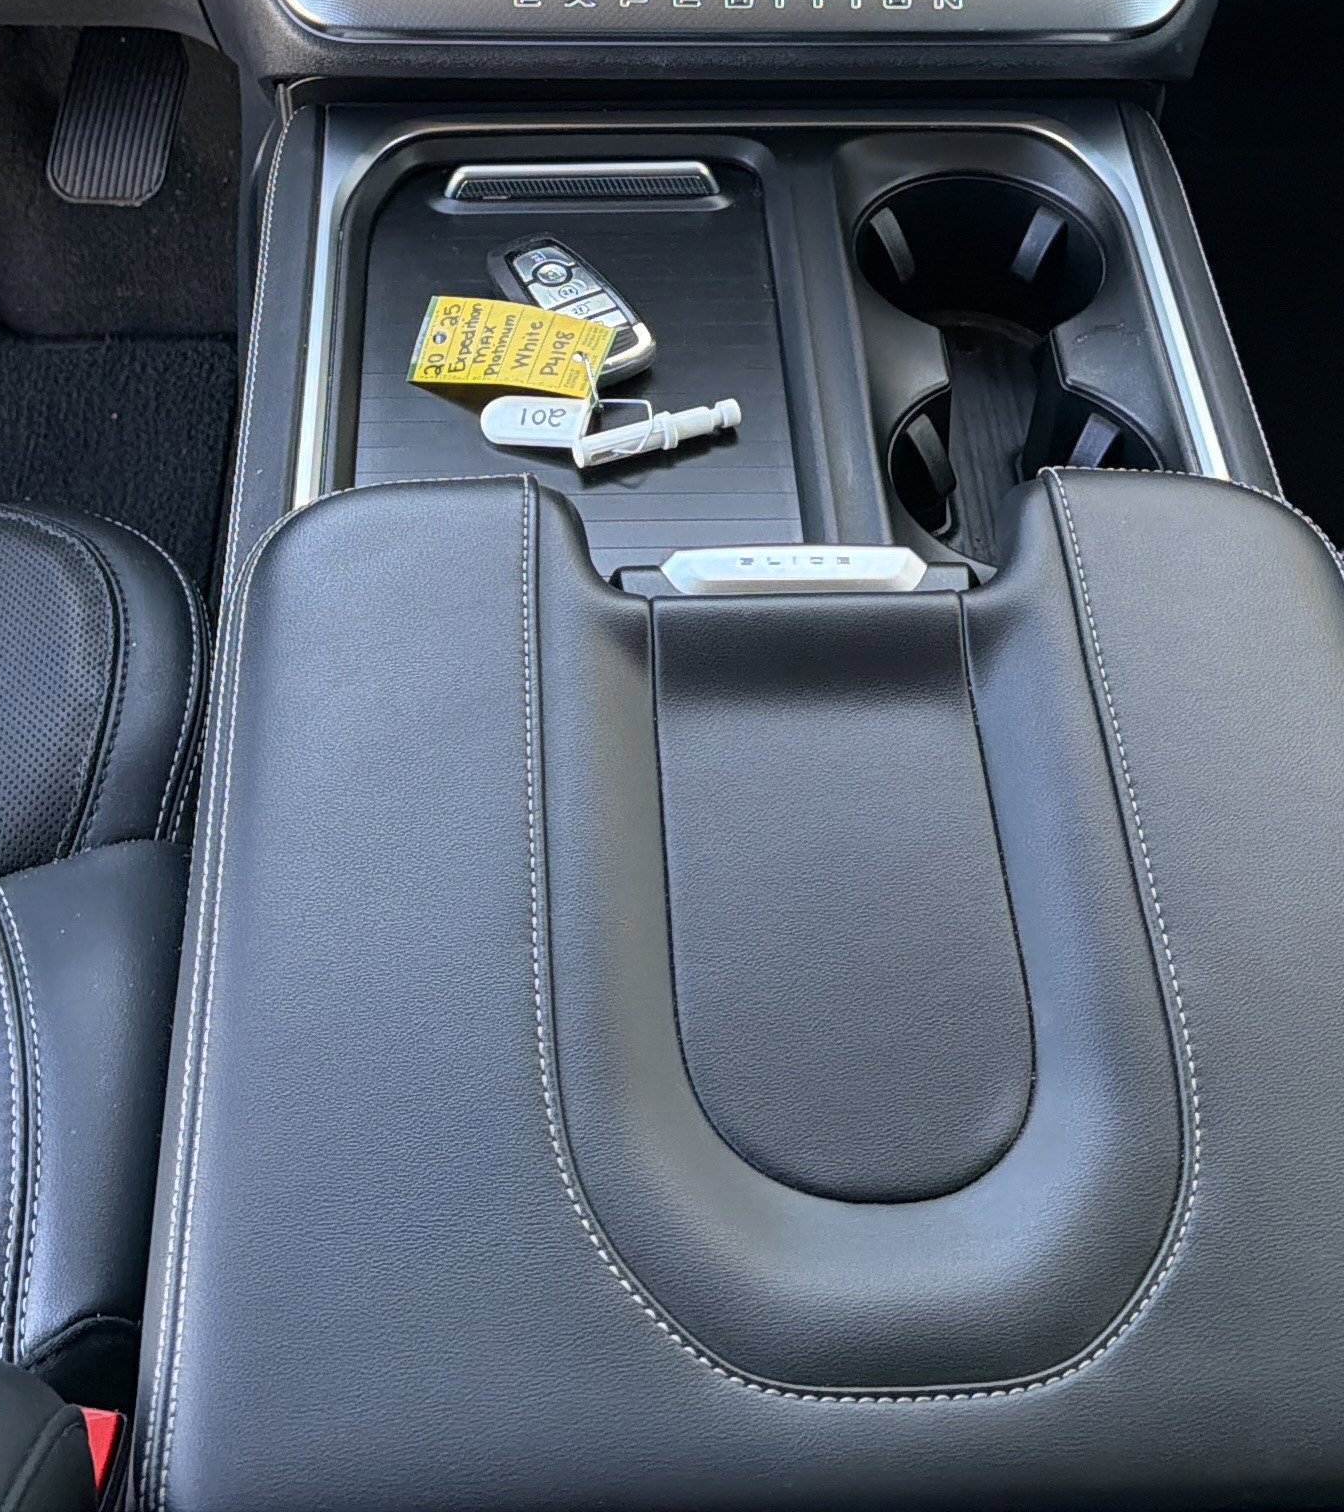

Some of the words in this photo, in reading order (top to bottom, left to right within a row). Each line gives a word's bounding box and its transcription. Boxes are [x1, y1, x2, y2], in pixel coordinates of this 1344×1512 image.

[423, 353, 445, 377] 20
[440, 303, 461, 327] 25
[511, 320, 544, 370] White
